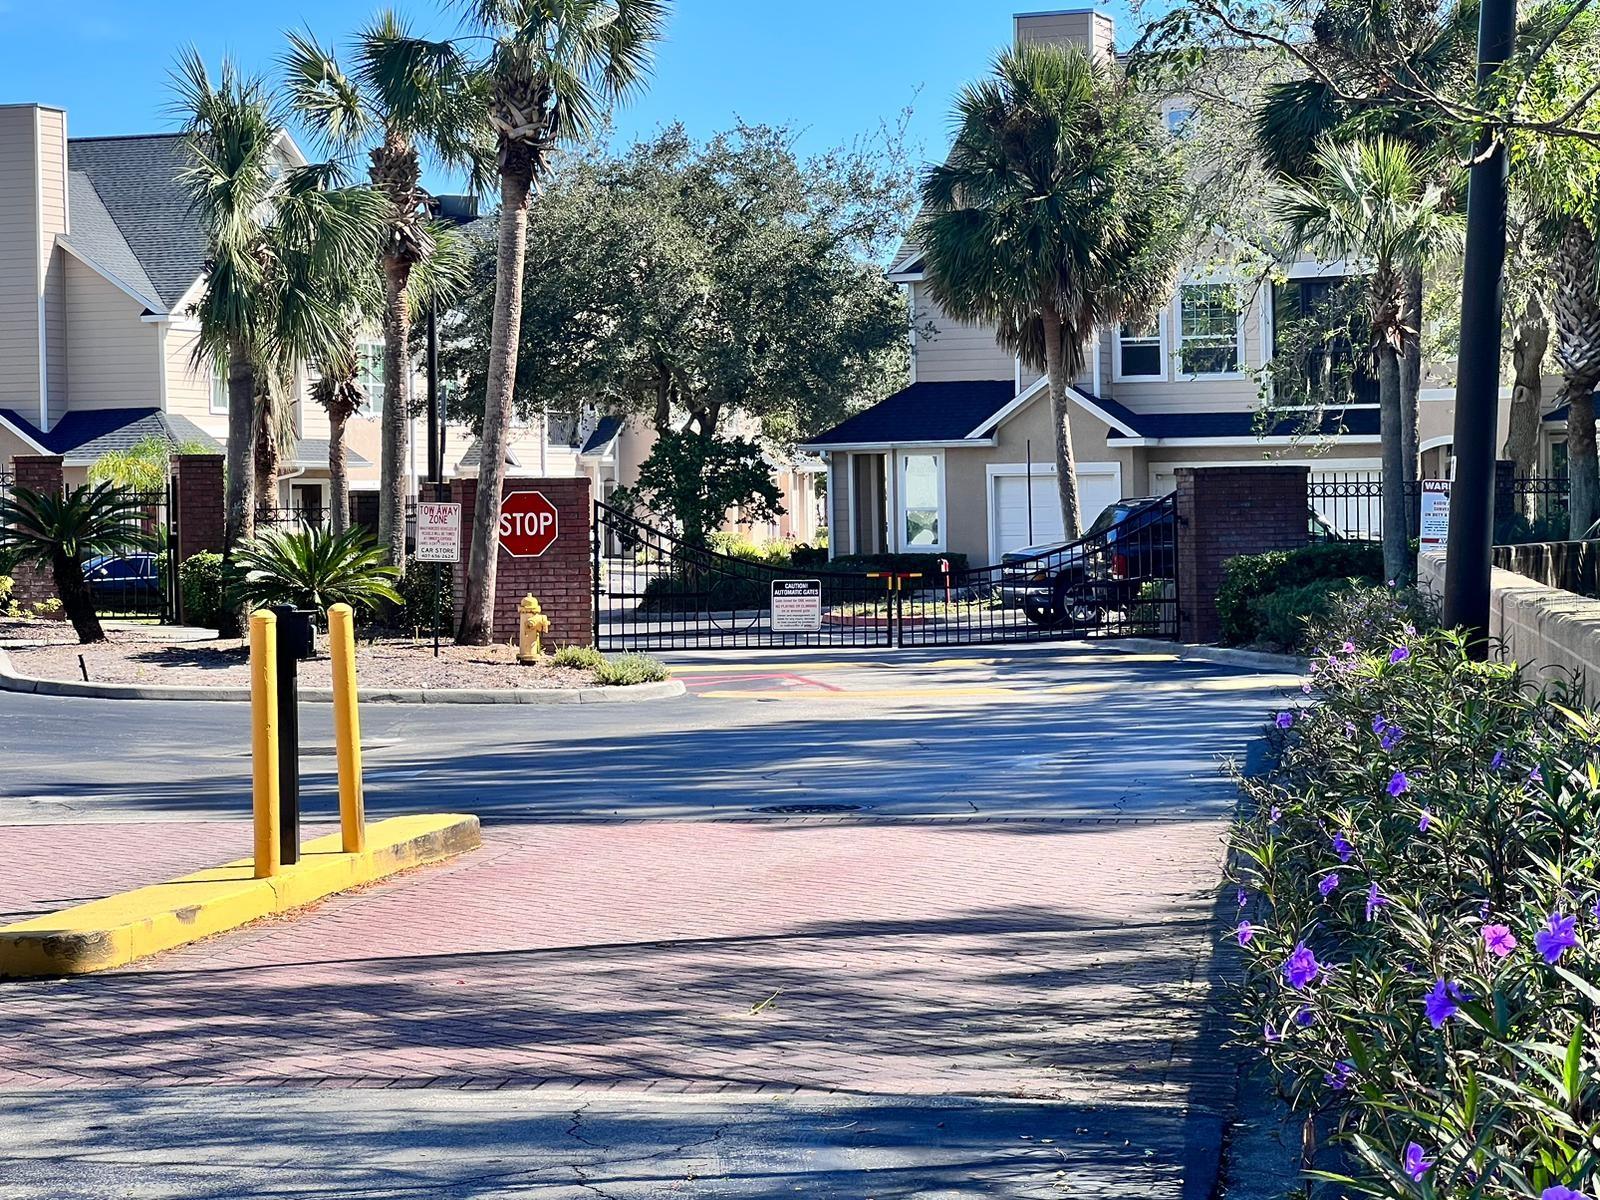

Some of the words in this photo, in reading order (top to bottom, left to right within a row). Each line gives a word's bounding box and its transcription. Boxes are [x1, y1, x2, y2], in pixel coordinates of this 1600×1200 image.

[1424, 482, 1450, 490] WAR
[420, 506, 434, 514] TOW
[437, 506, 458, 516] AWAY
[429, 515, 448, 524] ZONE
[499, 512, 553, 536] STOP
